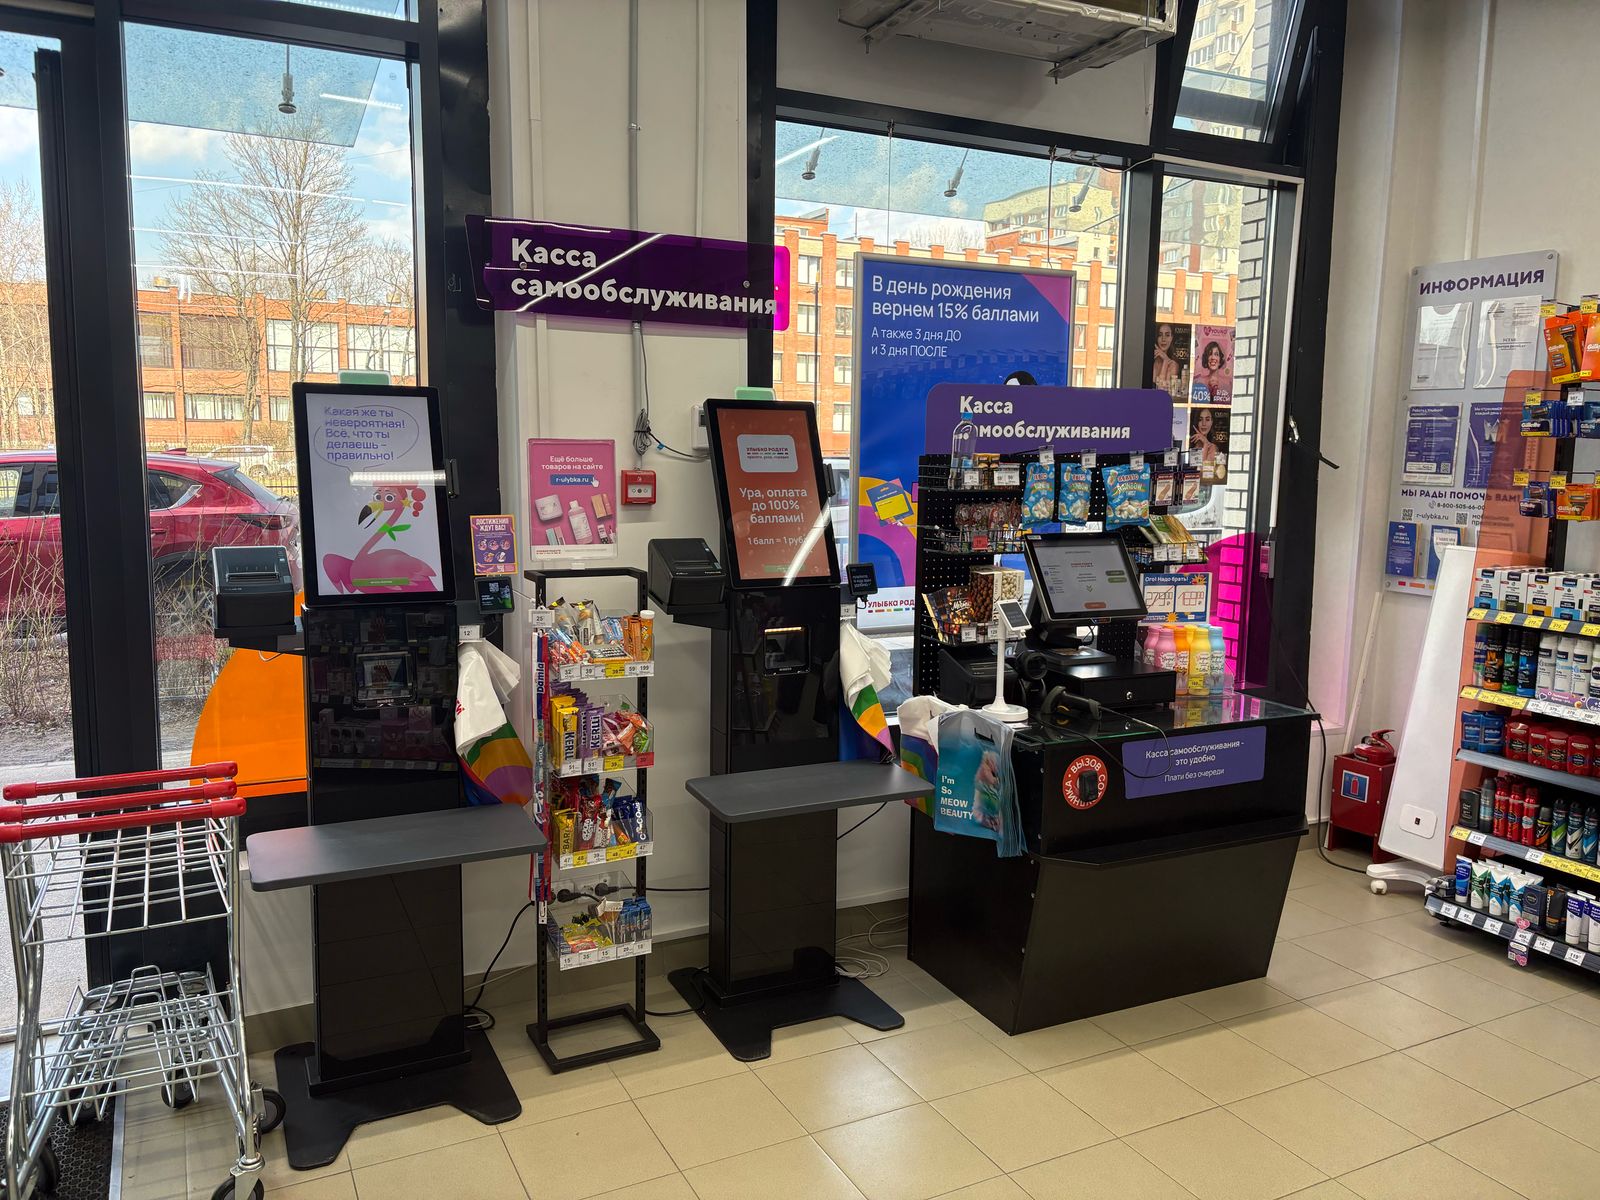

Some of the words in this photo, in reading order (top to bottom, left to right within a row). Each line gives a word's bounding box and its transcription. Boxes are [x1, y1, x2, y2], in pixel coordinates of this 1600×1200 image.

[511, 237, 597, 268] Касса
[872, 275, 883, 292] В
[886, 280, 928, 296] день
[931, 282, 1012, 300] рождения
[1420, 269, 1545, 295] ИНФОРМАЦИЯ
[511, 277, 777, 314] самообслуживания
[872, 302, 934, 320] вернем
[937, 303, 969, 320] 15%
[972, 305, 1040, 322] баллами
[871, 327, 879, 338] А
[880, 329, 913, 340] также
[915, 328, 921, 339] 3
[923, 331, 943, 341] дня
[945, 330, 962, 342] ДО
[871, 346, 878, 355] и
[880, 344, 886, 355] 3
[888, 346, 908, 356] дня
[910, 345, 948, 357] ПОСЛЕ
[1193, 390, 1211, 401] 40%
[960, 396, 1013, 414] Касса
[325, 406, 361, 418] Какая
[361, 409, 377, 418] же
[378, 409, 394, 418] ты
[325, 418, 406, 429] невероятная!
[325, 427, 350, 440] Всё,
[352, 431, 373, 439] что
[375, 431, 391, 439] ты
[326, 441, 379, 450] делаешь
[327, 451, 394, 462] правильно!
[549, 455, 565, 464] Ещё
[582, 463, 604, 471] сайте
[739, 488, 764, 498] Ура,
[767, 488, 808, 497] оплата
[1419, 490, 1447, 498] РАДЫ
[1449, 491, 1492, 501] ПОМОЧЬ
[752, 502, 766, 511] до
[768, 500, 800, 511] 100%
[750, 513, 804, 524] баллами!
[1416, 513, 1449, 521] r-ulybka.ru
[753, 537, 775, 545] балл
[537, 662, 545, 694] Damla
[1146, 749, 1169, 759] Касса
[1169, 740, 1240, 756] самообслуживания
[1070, 757, 1102, 773] ВЫЗОВ
[1189, 754, 1216, 765] удобно
[941, 775, 955, 785] I'm
[1164, 774, 1184, 782] Плати
[1185, 772, 1197, 780] без
[1198, 768, 1225, 778] очереди
[941, 786, 952, 795] So
[940, 797, 968, 808] MEOW
[940, 807, 974, 820] BEAUTY
